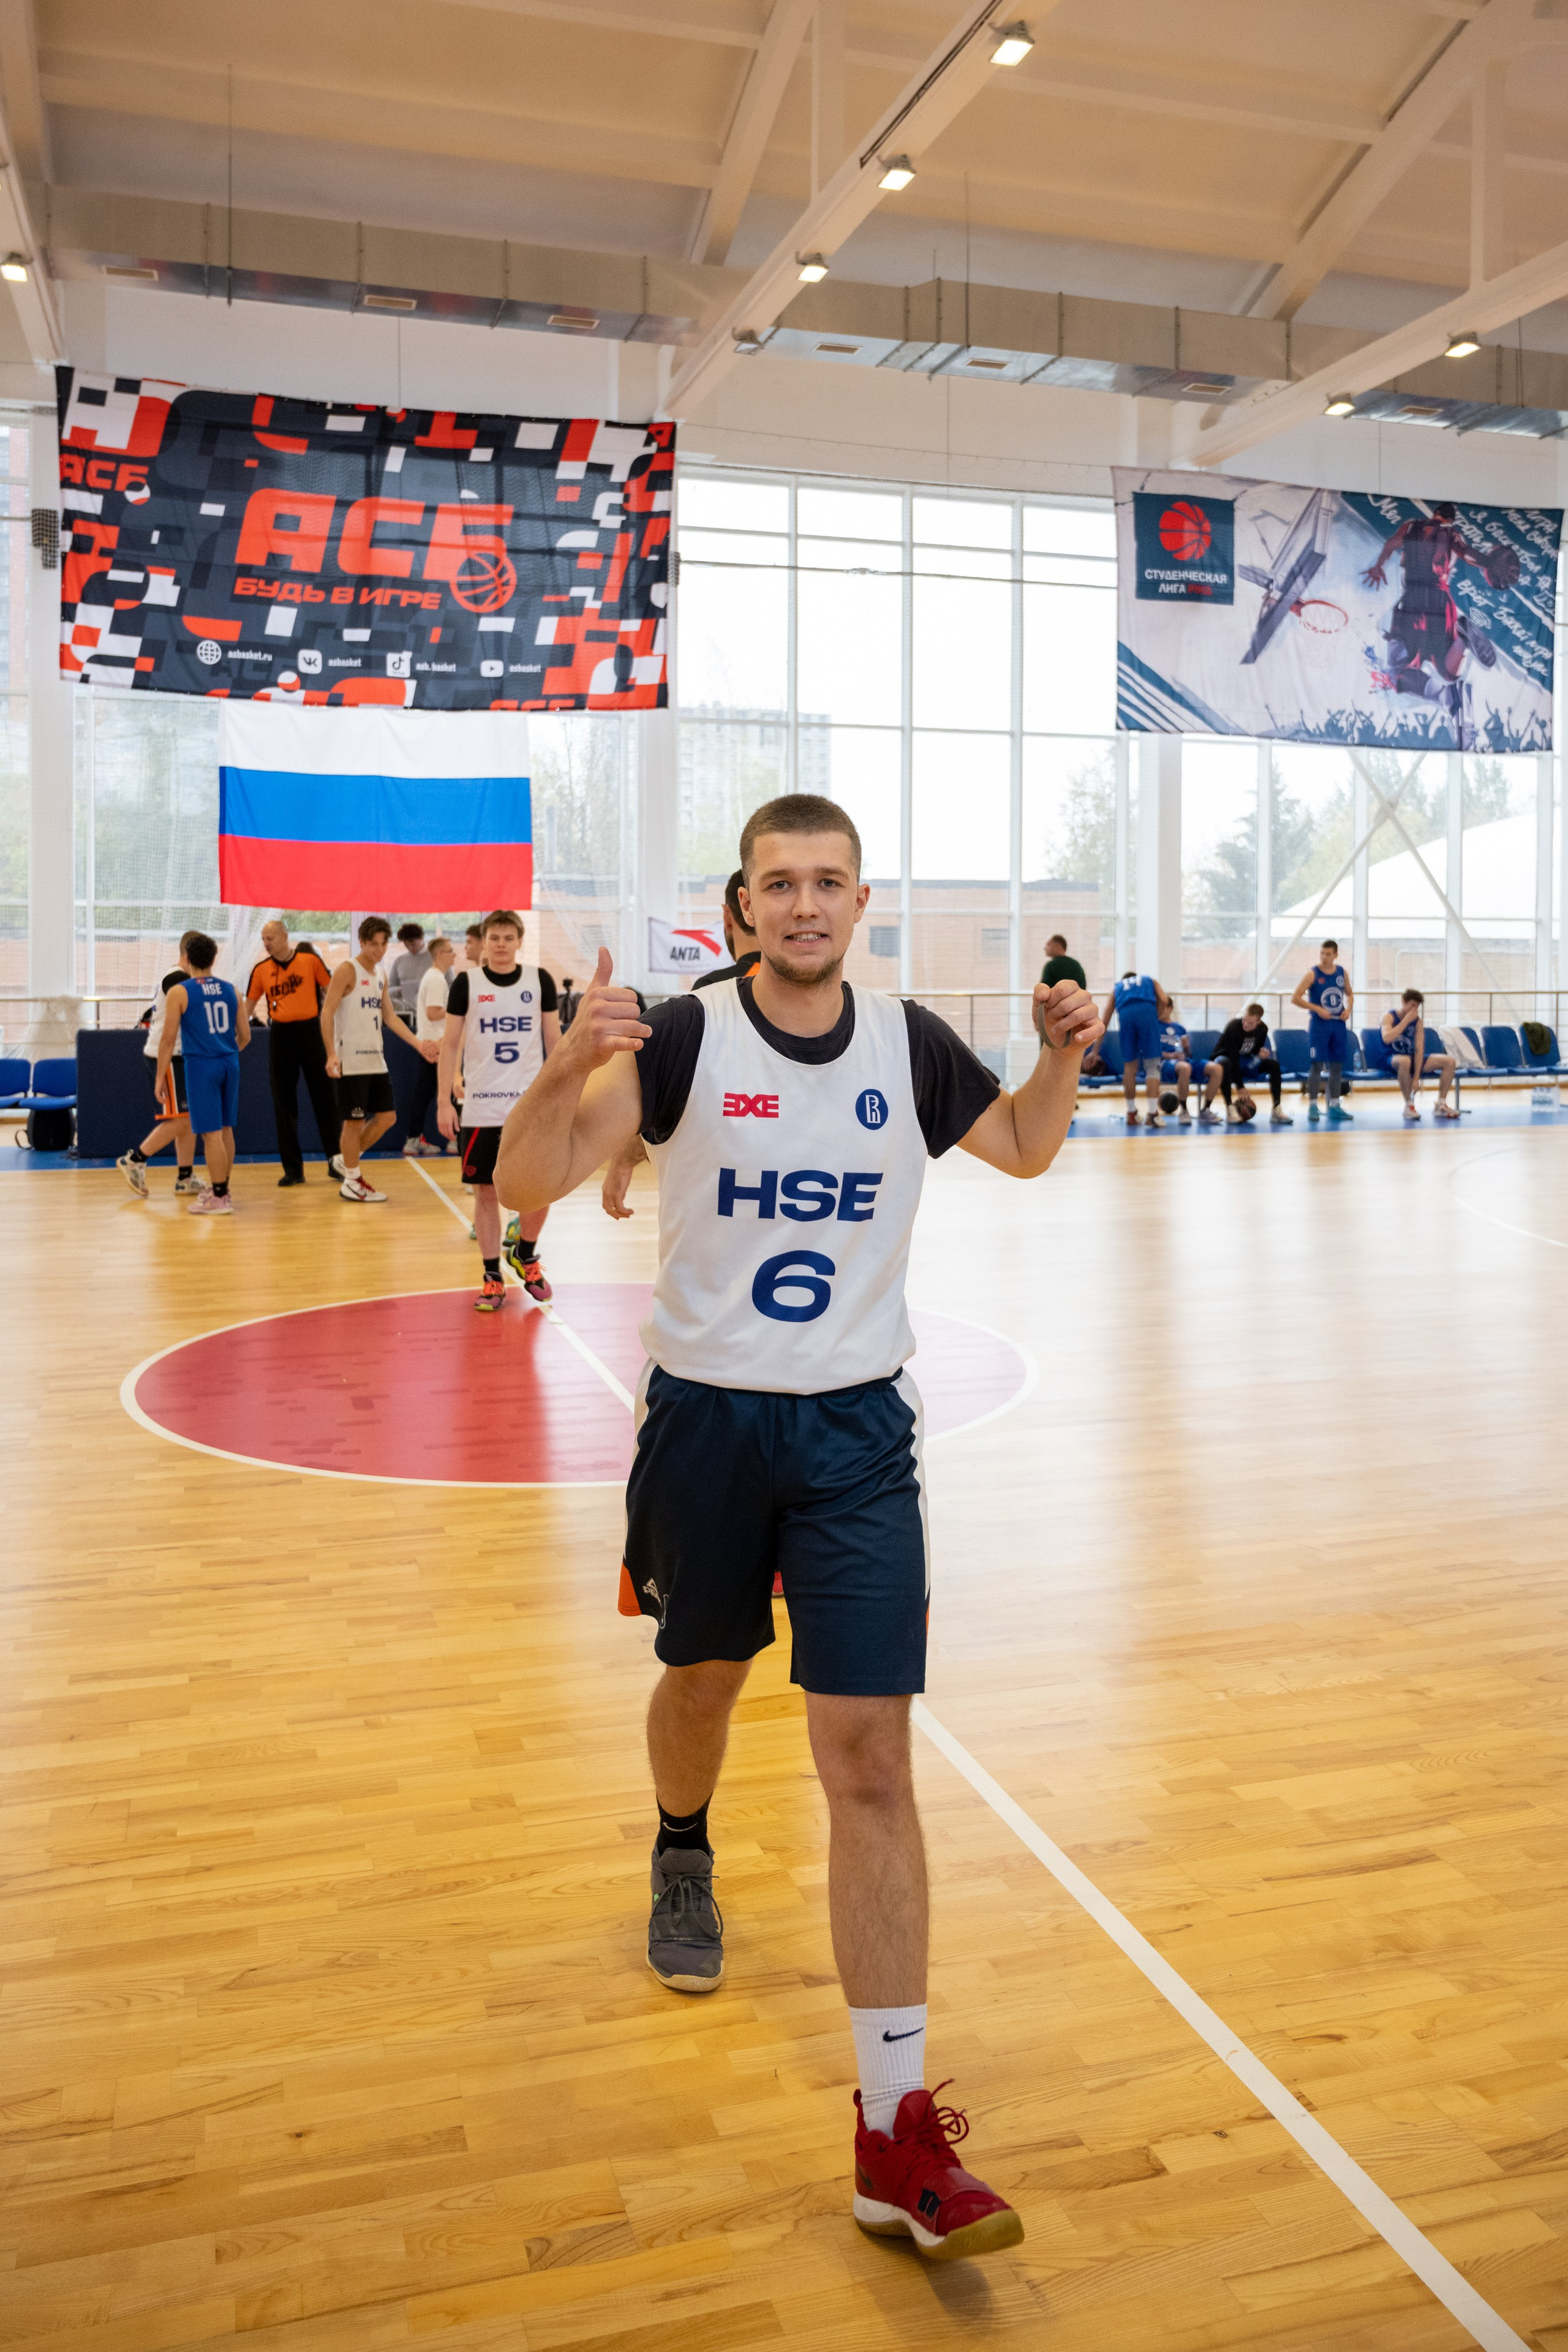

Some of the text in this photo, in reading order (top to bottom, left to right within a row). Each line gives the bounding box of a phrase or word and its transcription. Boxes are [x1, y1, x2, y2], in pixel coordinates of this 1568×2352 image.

[235, 488, 514, 582] АСБ
[1144, 568, 1227, 584] СТУДЕНЧЕСКАЯ
[233, 577, 442, 609] БУДЬ В ИГРЕ
[1159, 583, 1186, 594] ЛИГА
[227, 649, 273, 662] asbasket.ru
[328, 658, 361, 667] asbasket
[509, 663, 541, 673] asbasket
[670, 946, 700, 960] ANTA
[202, 982, 222, 995] HSE
[204, 1001, 229, 1035] 10
[480, 1016, 533, 1033] HSE
[494, 1042, 520, 1064] 5
[717, 1167, 884, 1222] HSE
[752, 1250, 836, 1323] 6
